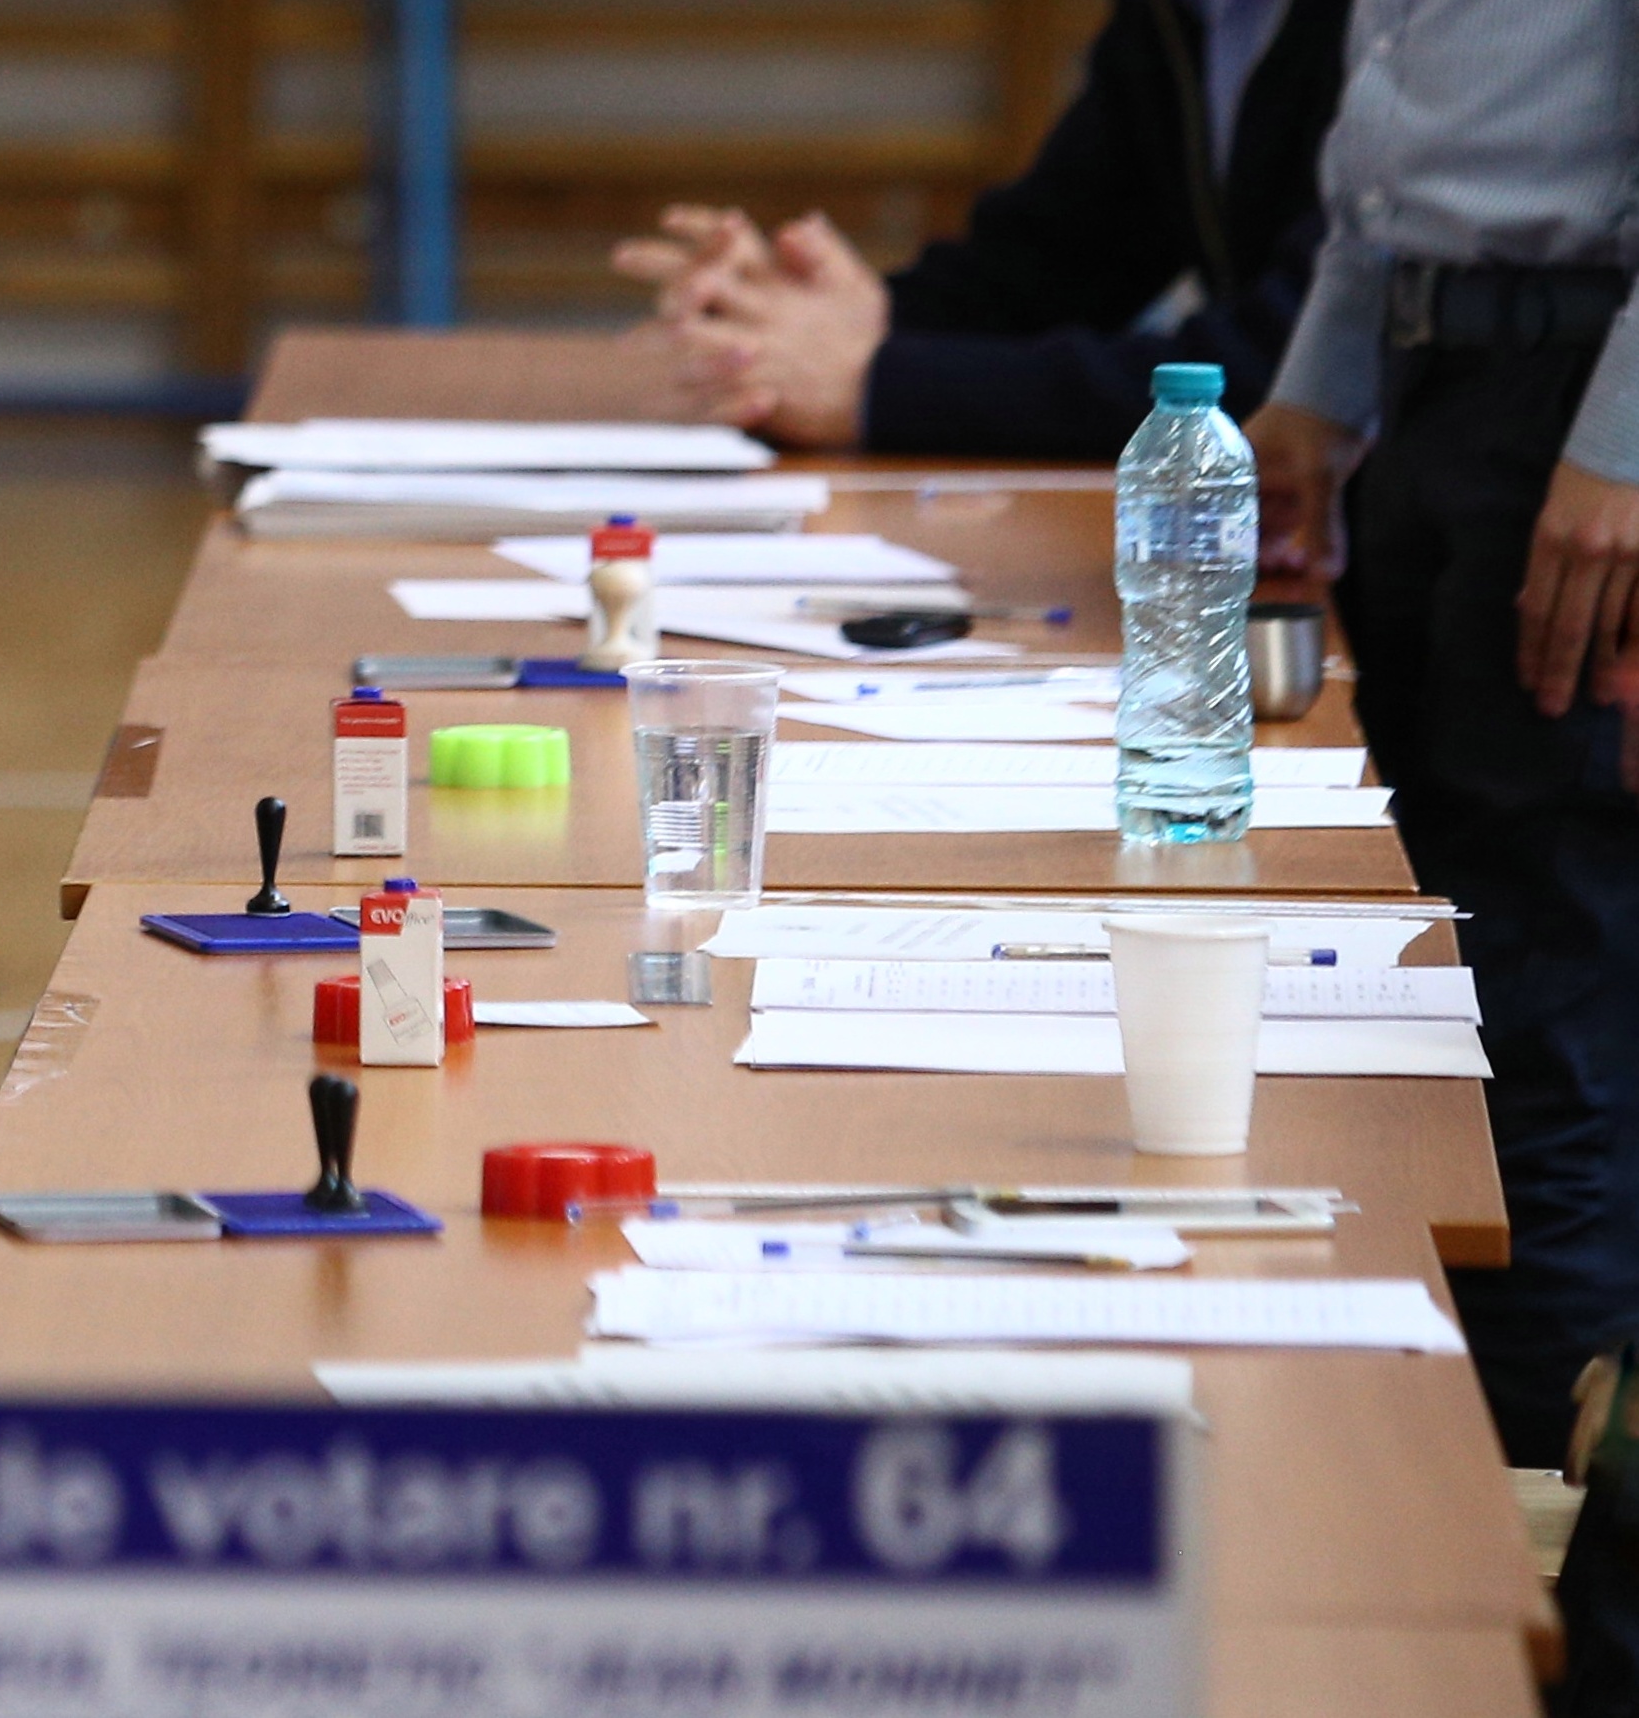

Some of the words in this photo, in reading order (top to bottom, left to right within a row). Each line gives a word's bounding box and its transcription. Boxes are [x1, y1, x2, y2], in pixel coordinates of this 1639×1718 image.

[147, 1435, 601, 1567] votare
[629, 1455, 819, 1574] nr.
[853, 1421, 1067, 1574] 64
